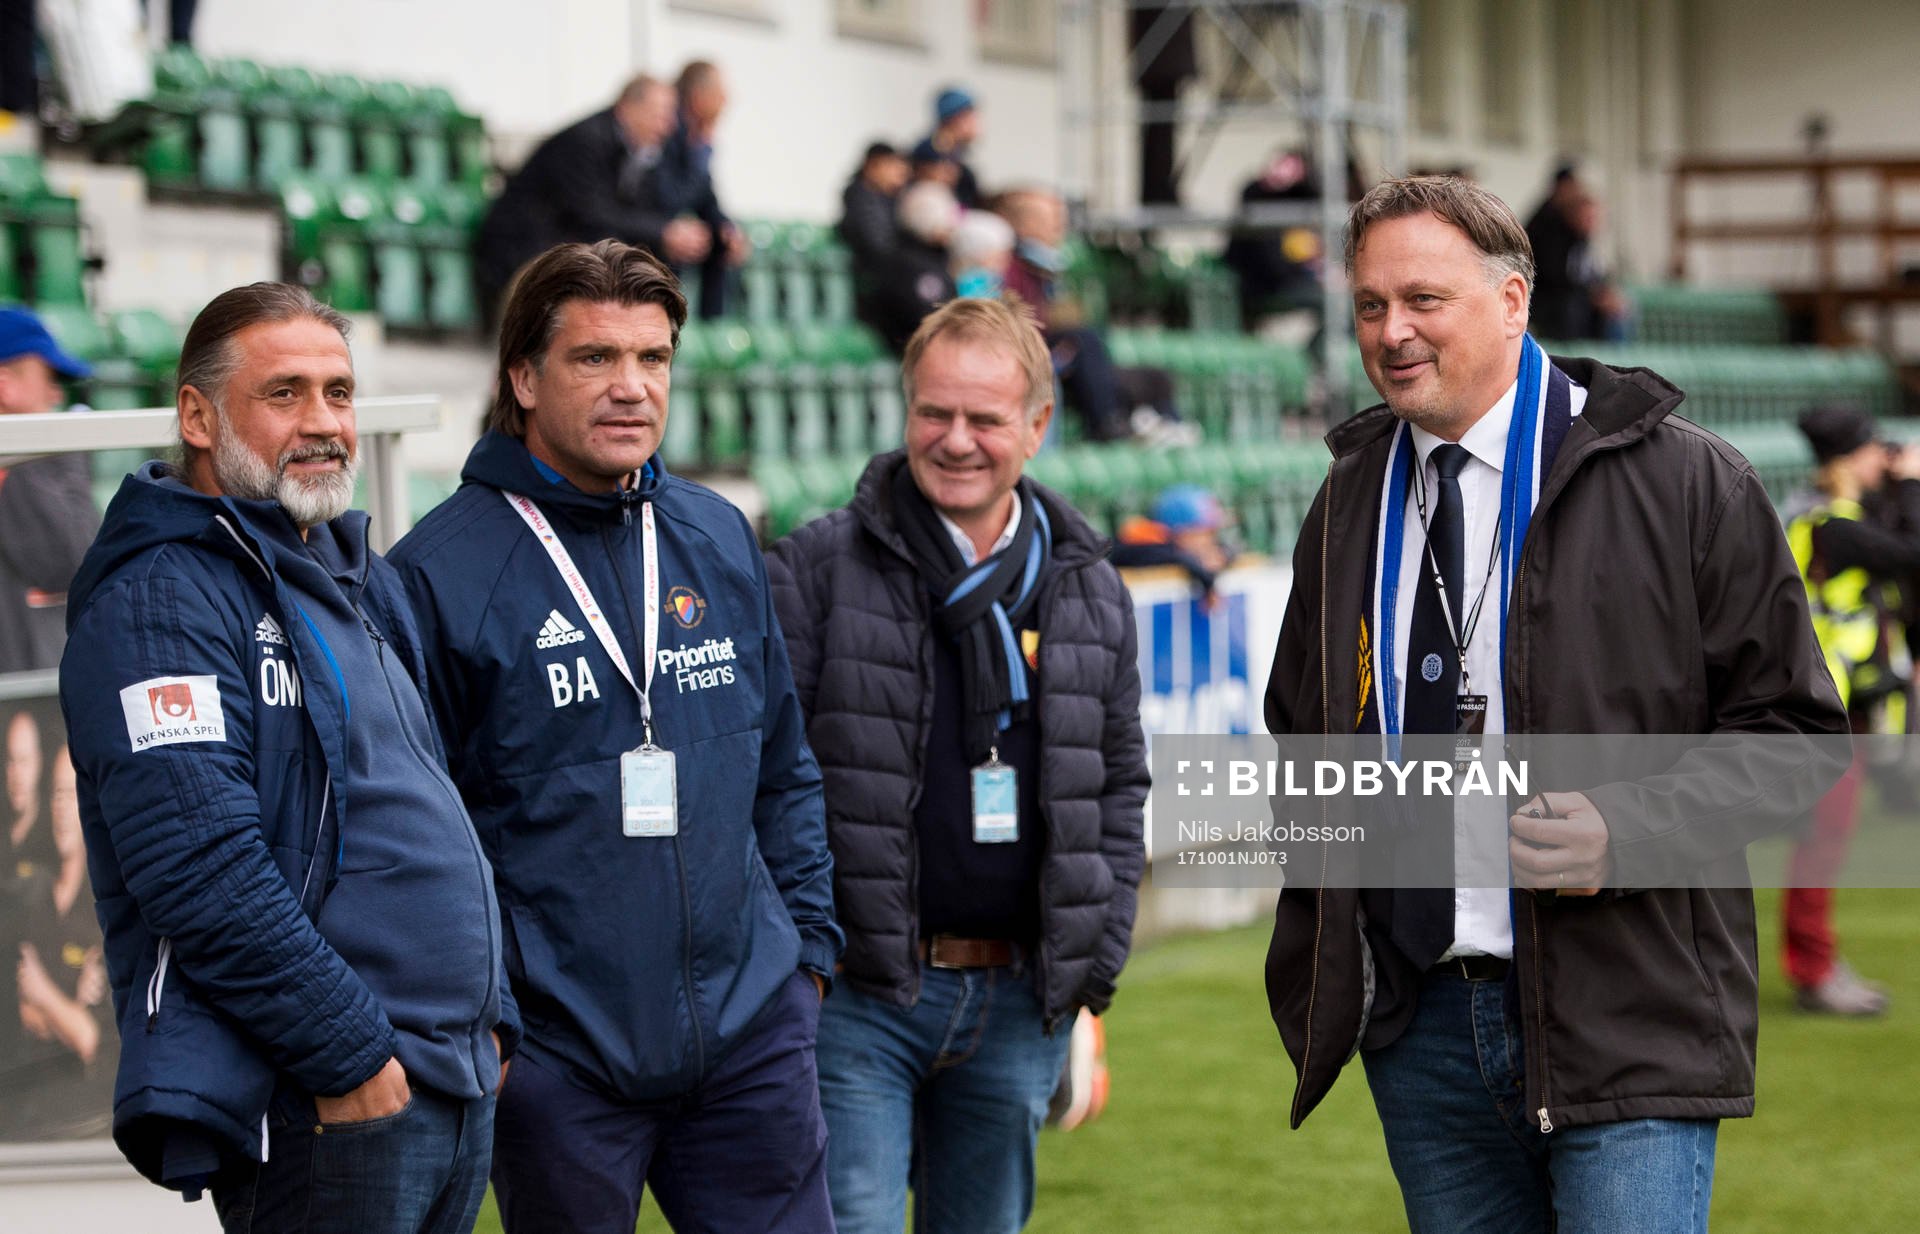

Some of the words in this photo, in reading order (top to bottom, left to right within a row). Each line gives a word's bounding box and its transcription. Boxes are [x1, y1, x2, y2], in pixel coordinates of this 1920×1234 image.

[536, 629, 586, 650] adidas
[657, 637, 737, 675] Prioritet
[260, 646, 302, 708] ÖM
[546, 656, 601, 709] BA
[675, 665, 736, 694] Finans
[136, 726, 191, 747] SVENSKA
[194, 726, 221, 736] SPEL
